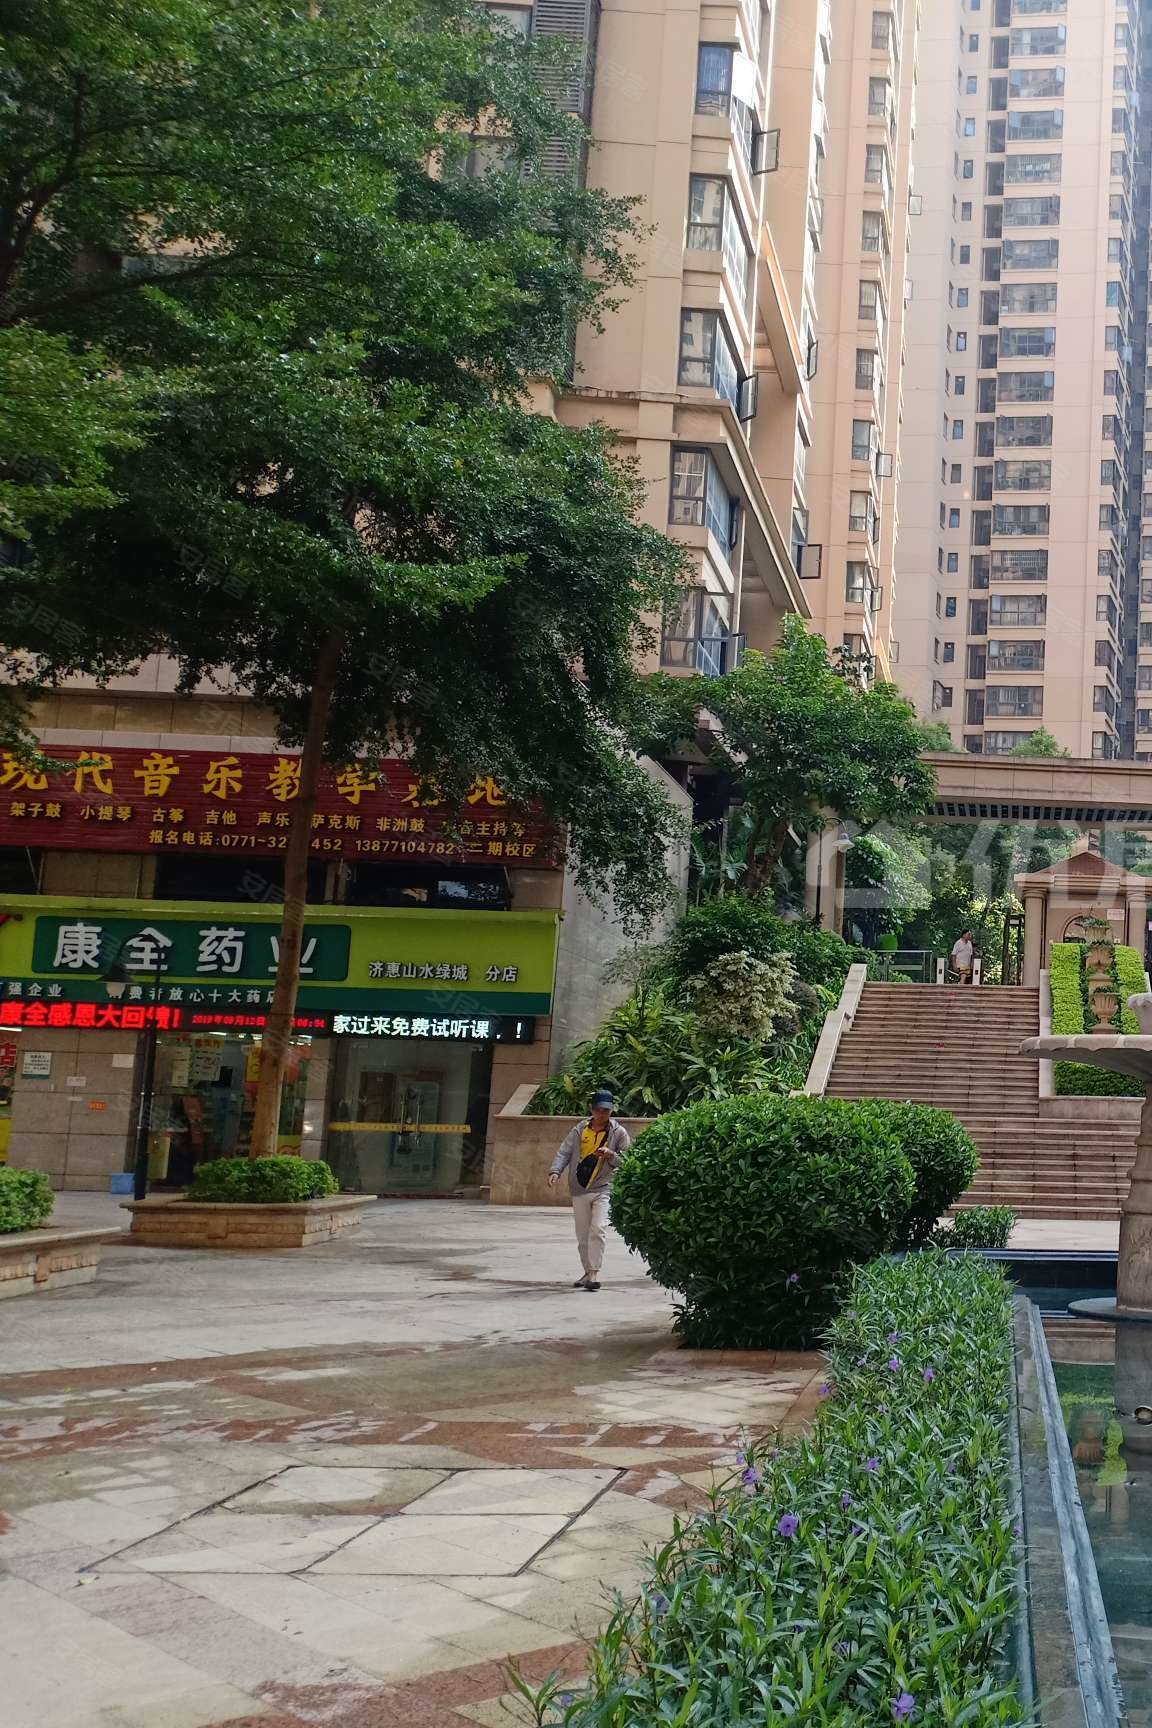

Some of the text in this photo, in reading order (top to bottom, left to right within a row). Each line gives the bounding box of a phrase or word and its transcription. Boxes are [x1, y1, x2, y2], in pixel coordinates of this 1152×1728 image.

[10, 802, 62, 819] 架子鼓
[80, 805, 133, 821] 小提琴
[152, 807, 184, 824] 古筝
[205, 809, 238, 825] 吉他
[256, 811, 290, 828] 声乐
[376, 816, 425, 833] 非洲鼓
[53, 922, 317, 973] 康全药业
[369, 961, 518, 982] 济惠山水绿城 分店
[0, 982, 62, 998] 强企业
